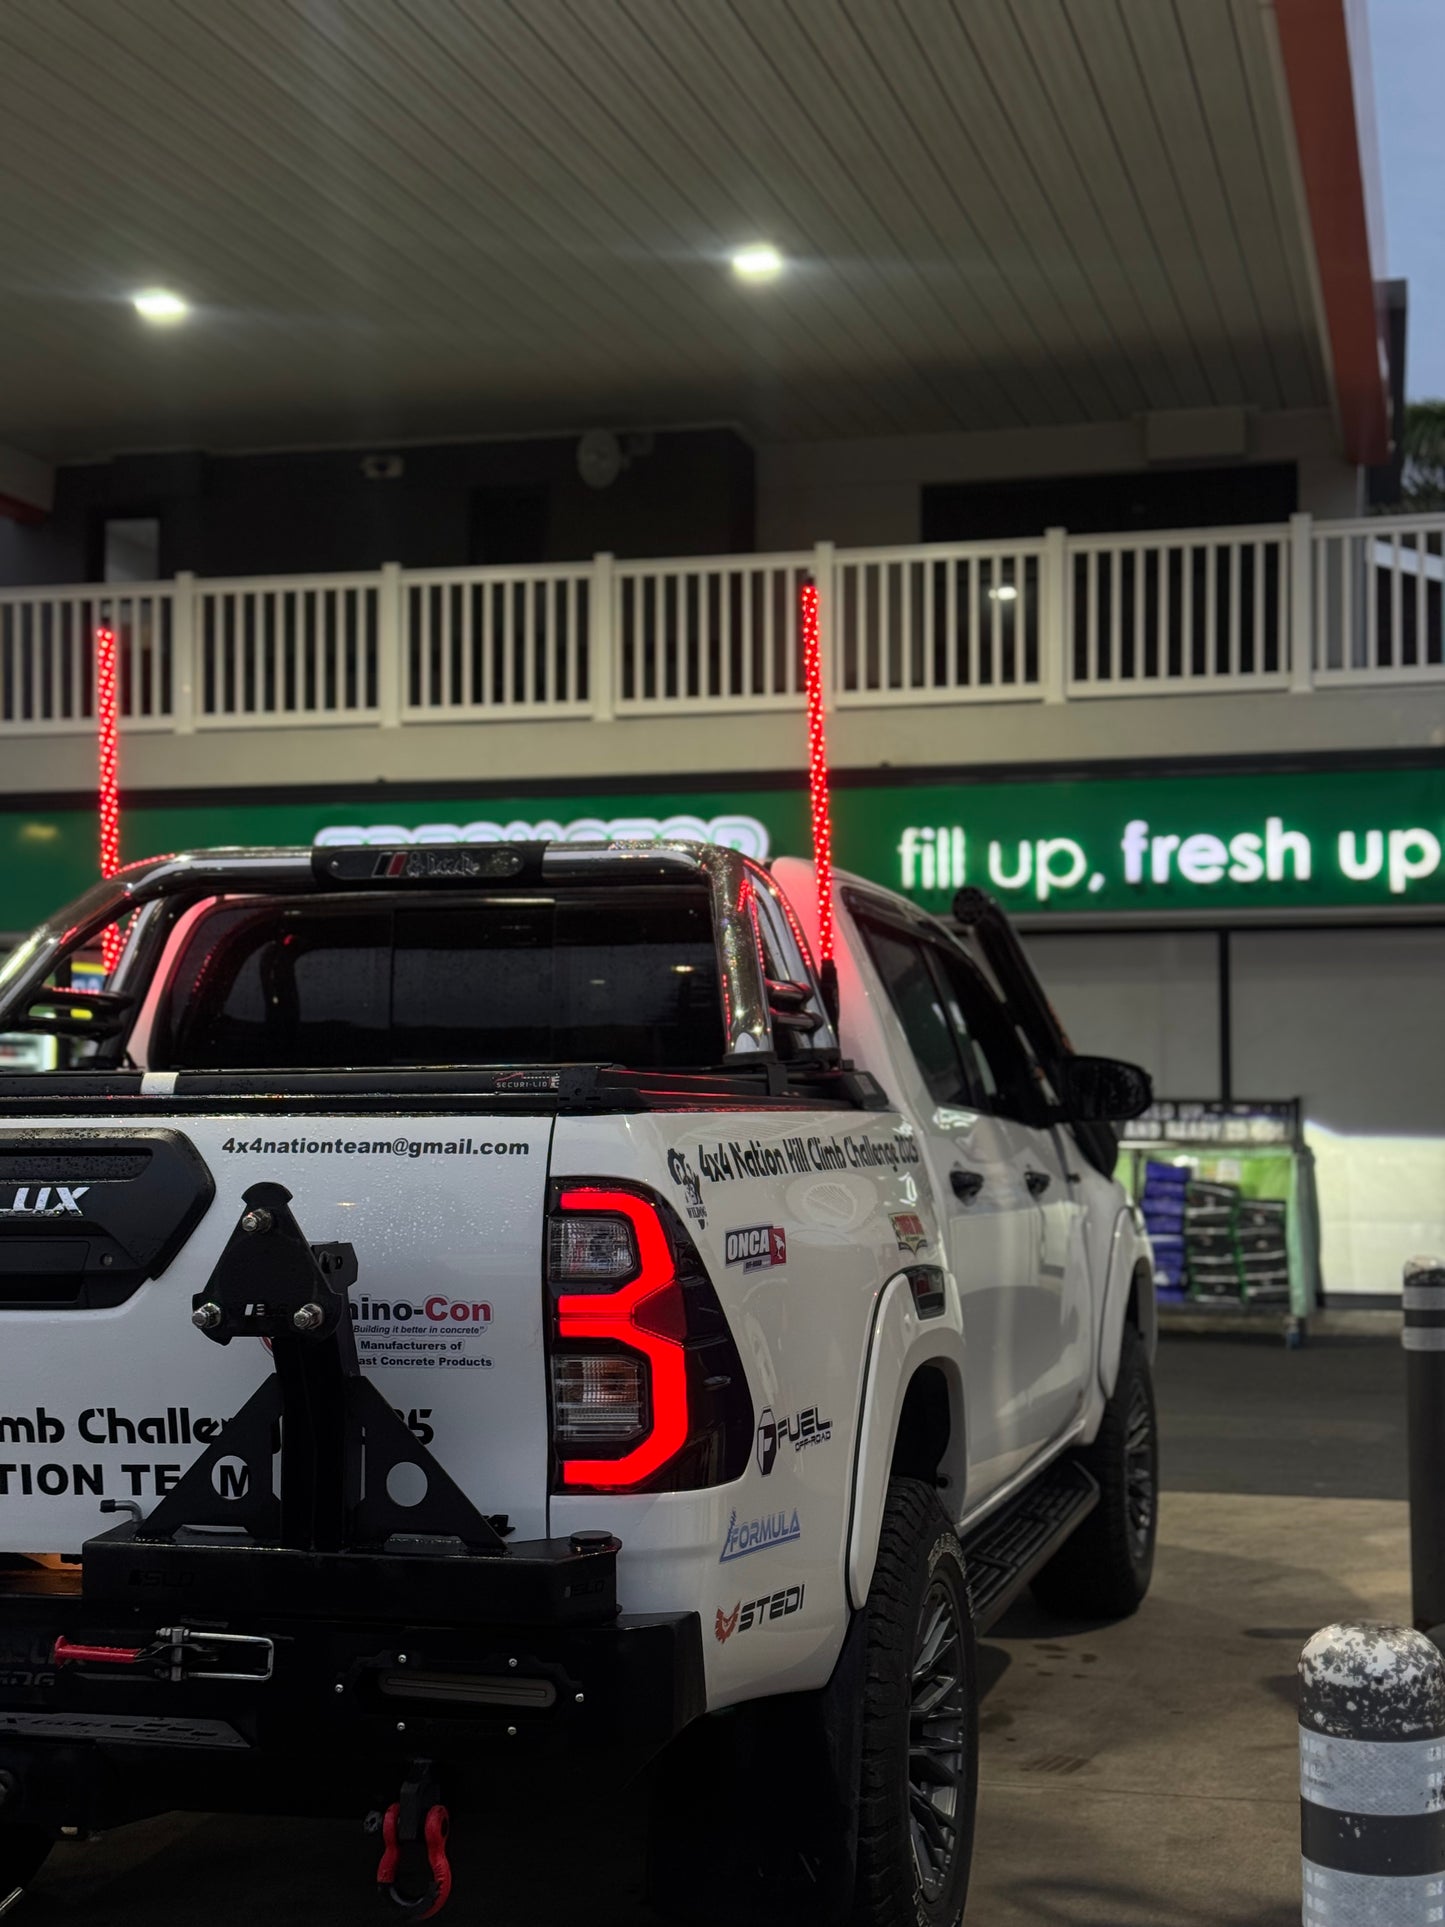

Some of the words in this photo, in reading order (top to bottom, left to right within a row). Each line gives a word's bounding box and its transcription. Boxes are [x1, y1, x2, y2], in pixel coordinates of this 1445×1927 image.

[898, 826, 966, 889] fill
[988, 837, 1105, 900] up,
[1122, 816, 1312, 884] fresh
[1338, 827, 1442, 893] up
[222, 1137, 530, 1158] 4x4nationteam@gmail.com
[698, 1143, 735, 1182] 4x4
[728, 1139, 789, 1179] Nation
[783, 1137, 812, 1173] Hill
[807, 1136, 847, 1171] Climb
[843, 1134, 899, 1172] Challenge
[727, 1229, 770, 1261] ONCA
[360, 1340, 446, 1350] Manufacturers
[449, 1341, 463, 1350] of
[392, 1325, 399, 1333] it
[400, 1326, 427, 1334] better
[429, 1326, 438, 1334] in
[358, 1356, 377, 1366] ast
[380, 1356, 435, 1366] Concrete
[438, 1357, 493, 1367] Products
[777, 1406, 831, 1450] FUEL
[121, 1463, 250, 1499] TEM
[730, 1510, 801, 1553] FORMULA
[738, 1583, 805, 1633] STEDI
